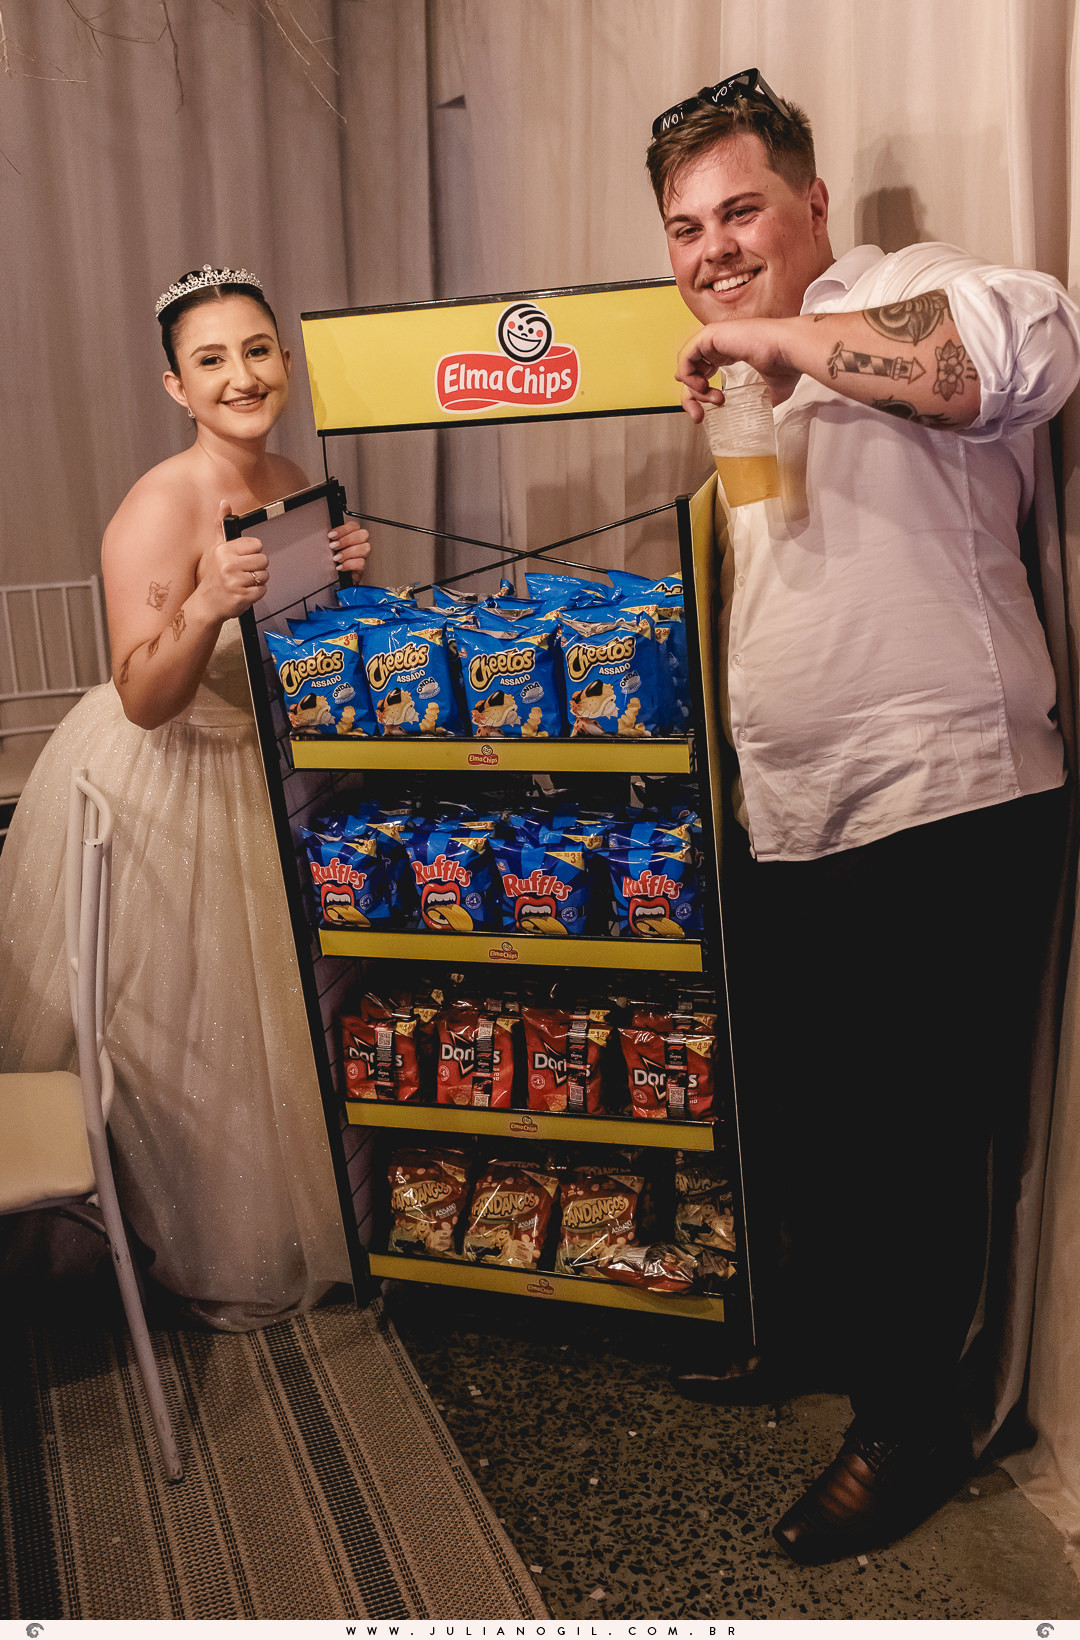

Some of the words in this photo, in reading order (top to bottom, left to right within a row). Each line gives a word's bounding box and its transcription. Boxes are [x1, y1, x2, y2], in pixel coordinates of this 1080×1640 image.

[444, 363, 504, 394] Elma
[506, 365, 573, 399] Chips
[367, 643, 428, 691] Cheetos
[470, 649, 534, 691] Cheetos
[567, 638, 635, 681] Cheetos
[598, 662, 631, 675] ASSADO
[280, 649, 344, 696] Cheetos
[311, 675, 342, 688] ASSADO
[396, 669, 426, 682] ASSADO
[500, 674, 531, 686] ASSADO
[620, 671, 638, 687] ONDA
[333, 683, 351, 698] ONDA
[417, 678, 435, 693] ONDA
[521, 682, 540, 697] ONDA
[310, 858, 367, 889] Ruffles
[411, 855, 471, 887] Ruffles
[502, 869, 572, 900] Ruffles
[623, 870, 682, 899] Ruffles
[350, 1047, 404, 1067] Dors
[441, 1044, 500, 1064] Doris
[634, 1069, 698, 1088] Dors
[473, 1193, 537, 1218] FANDANGOS
[563, 1197, 626, 1229] FANDANGOS
